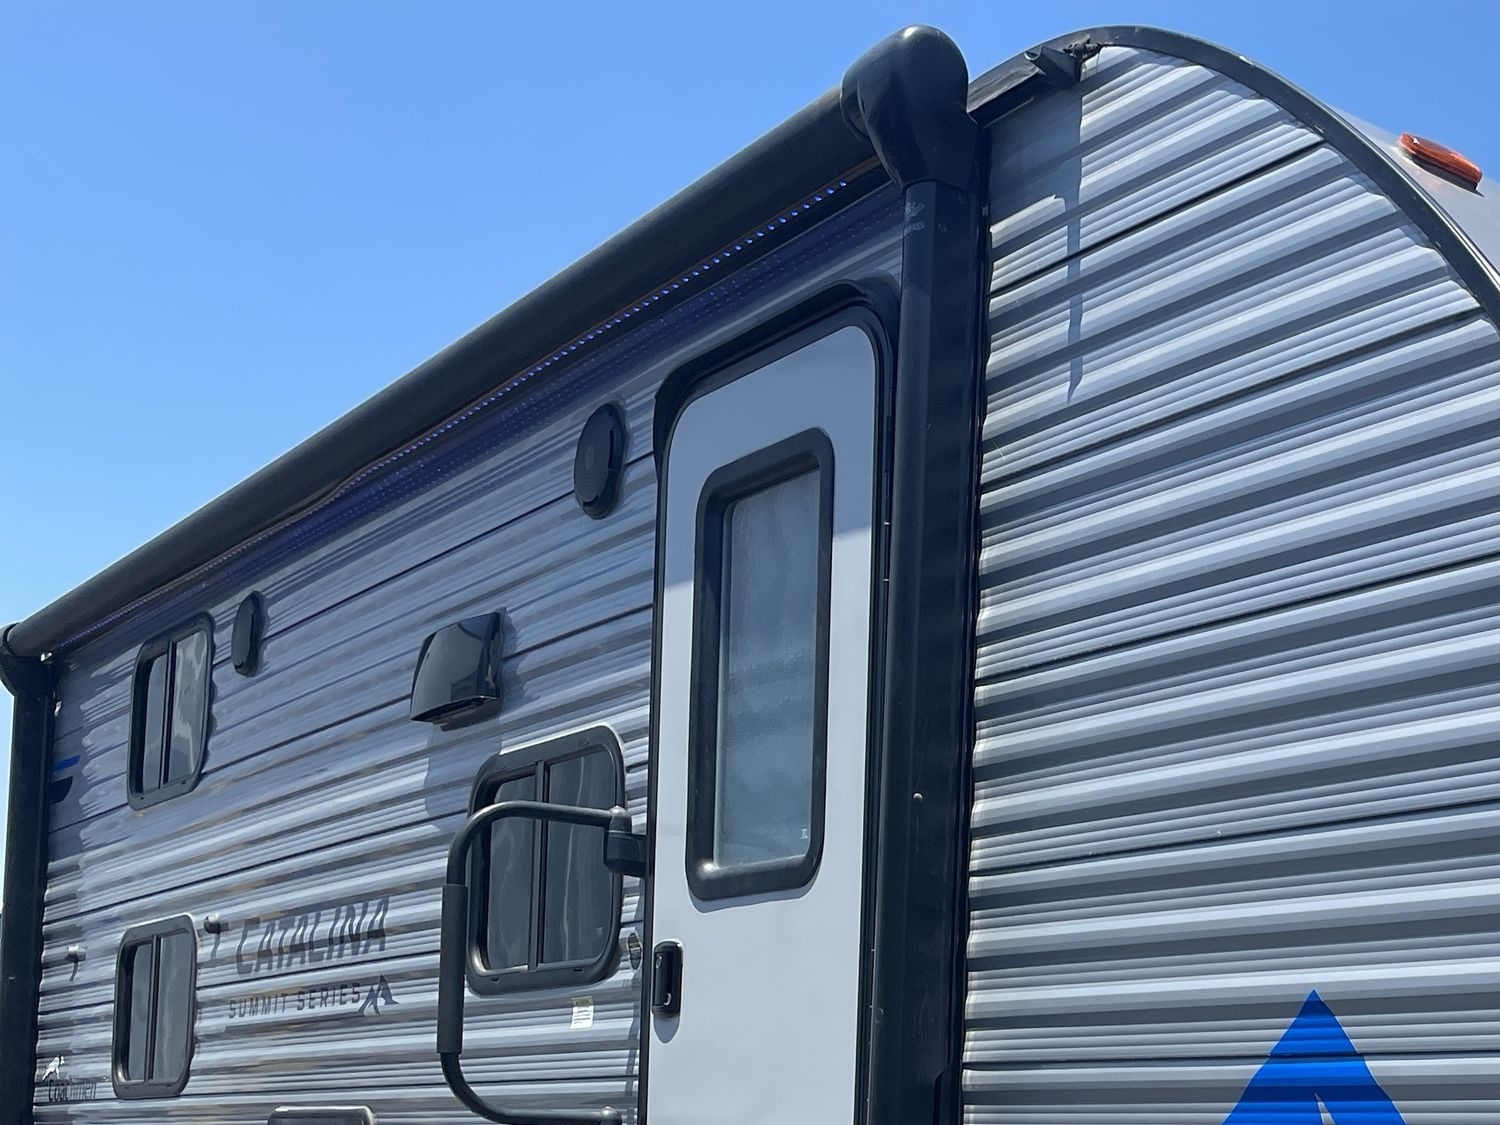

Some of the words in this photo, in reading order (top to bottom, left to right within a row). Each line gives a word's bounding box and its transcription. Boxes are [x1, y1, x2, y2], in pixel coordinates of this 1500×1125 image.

[236, 895, 389, 975] CATALINA
[229, 993, 288, 1018] SUMMIT
[297, 982, 361, 1011] SERIES
